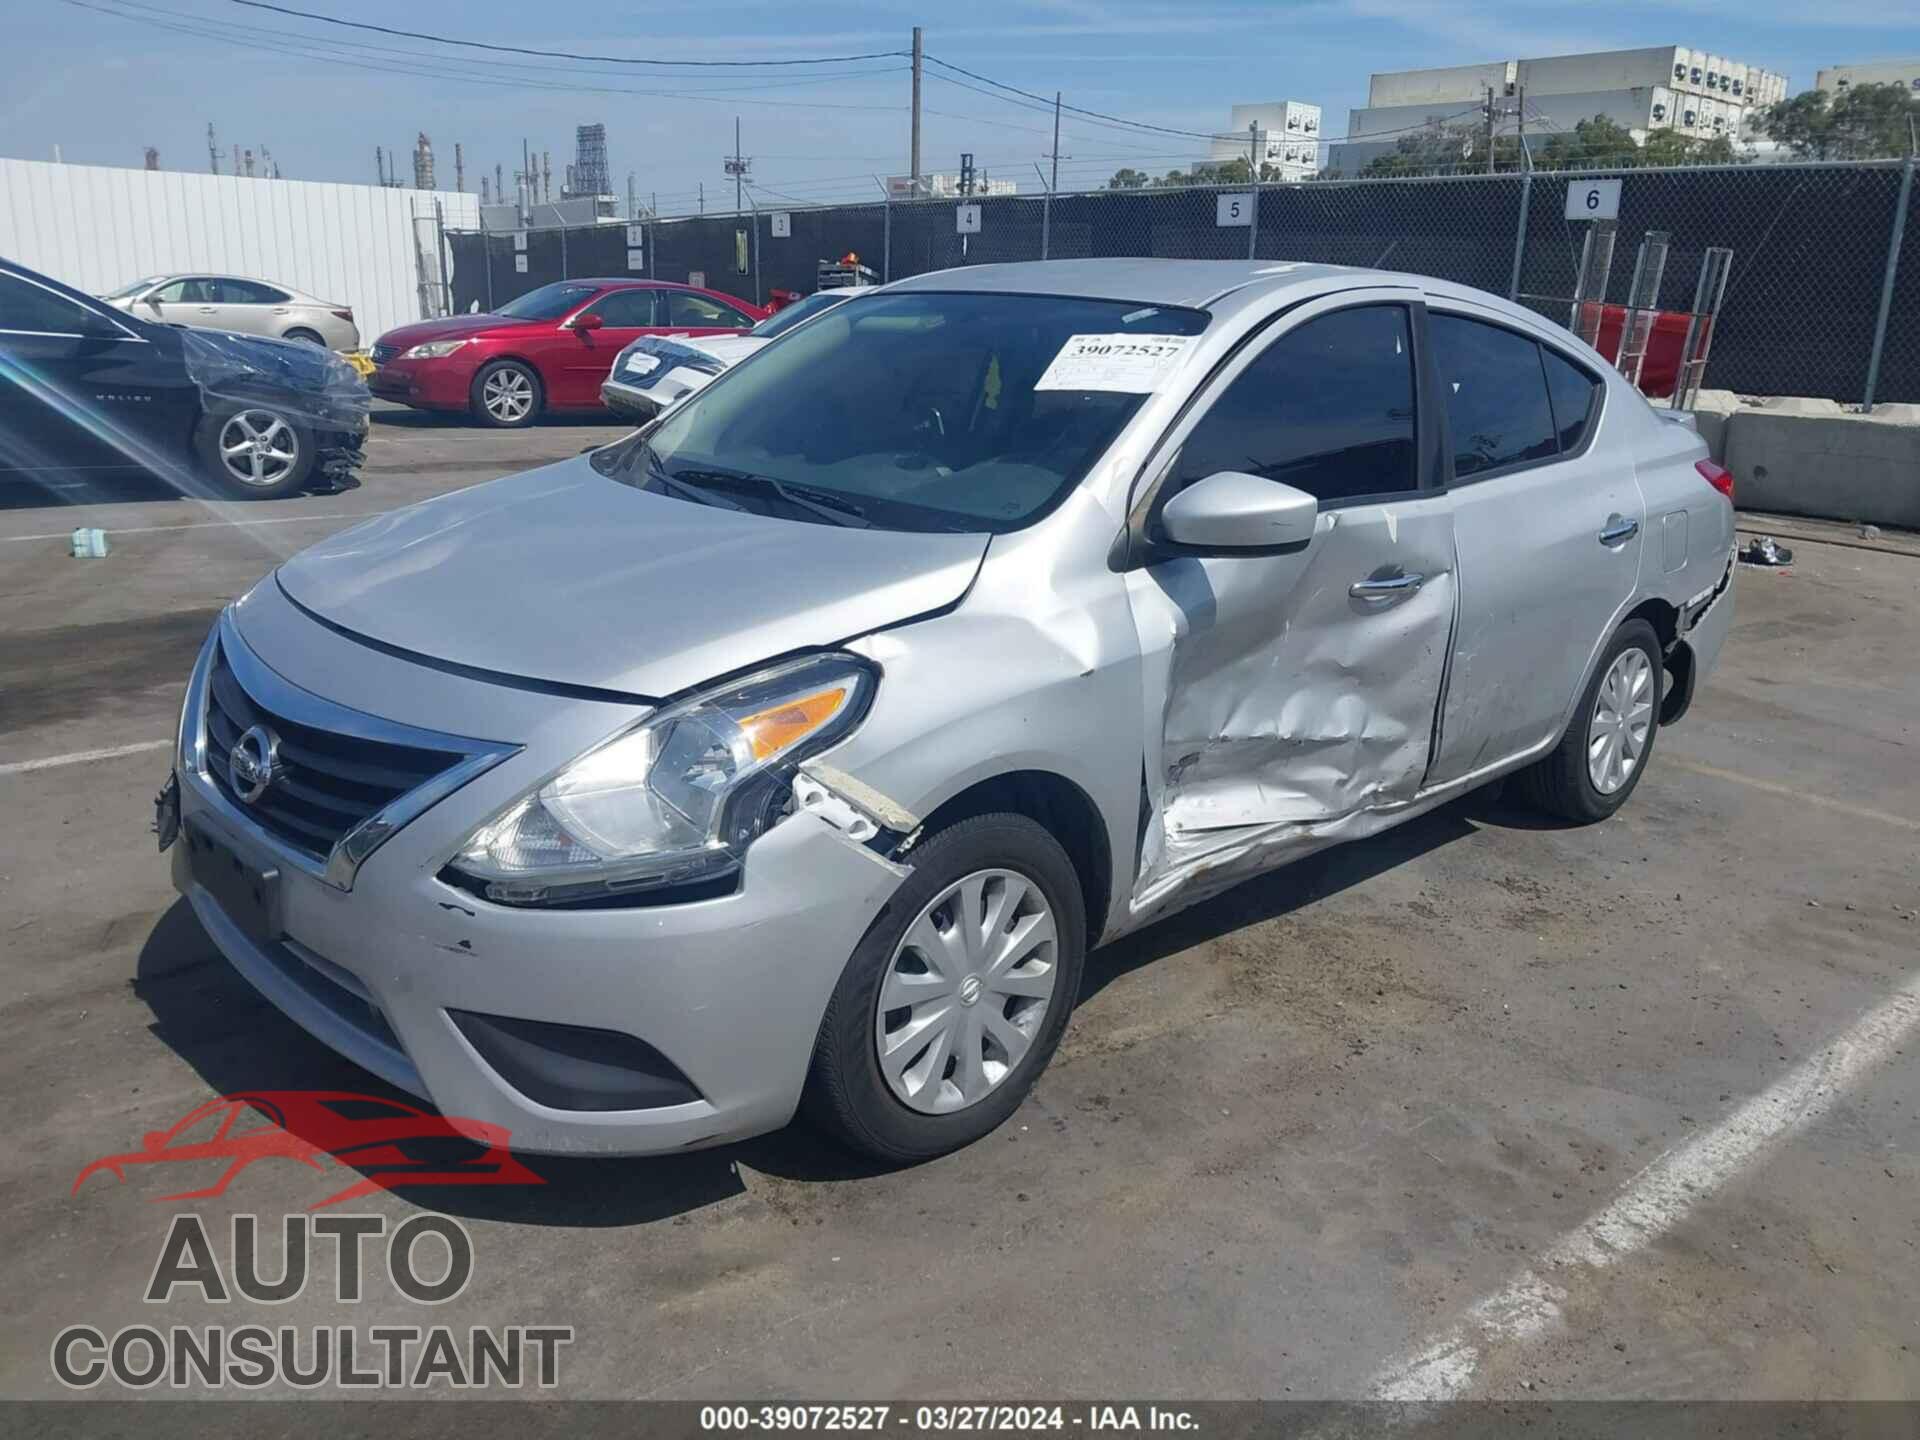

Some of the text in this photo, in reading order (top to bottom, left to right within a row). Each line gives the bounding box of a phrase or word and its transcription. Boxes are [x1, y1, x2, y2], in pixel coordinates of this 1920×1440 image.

[1586, 190, 1600, 210] 6
[1230, 202, 1240, 218] 5
[966, 212, 972, 225] 4
[1071, 344, 1179, 357] 39072527
